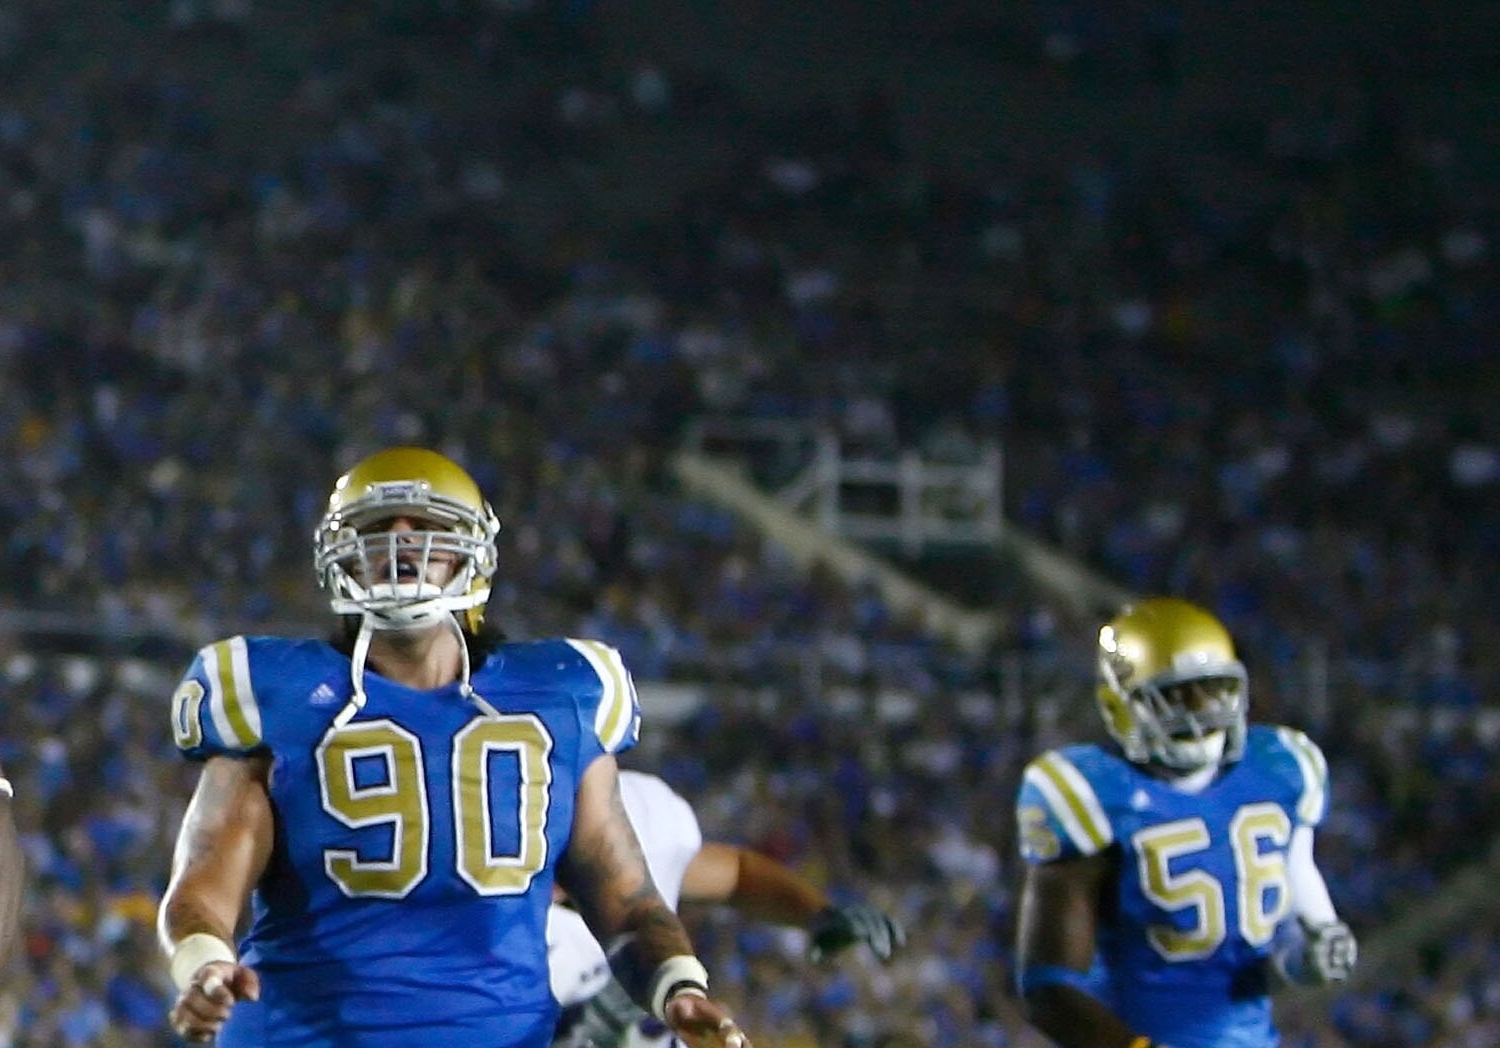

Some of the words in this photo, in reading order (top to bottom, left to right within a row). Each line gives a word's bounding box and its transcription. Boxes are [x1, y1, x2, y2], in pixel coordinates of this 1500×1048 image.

[171, 680, 205, 751] 0
[316, 714, 553, 900] 90
[1132, 801, 1293, 963] 56
